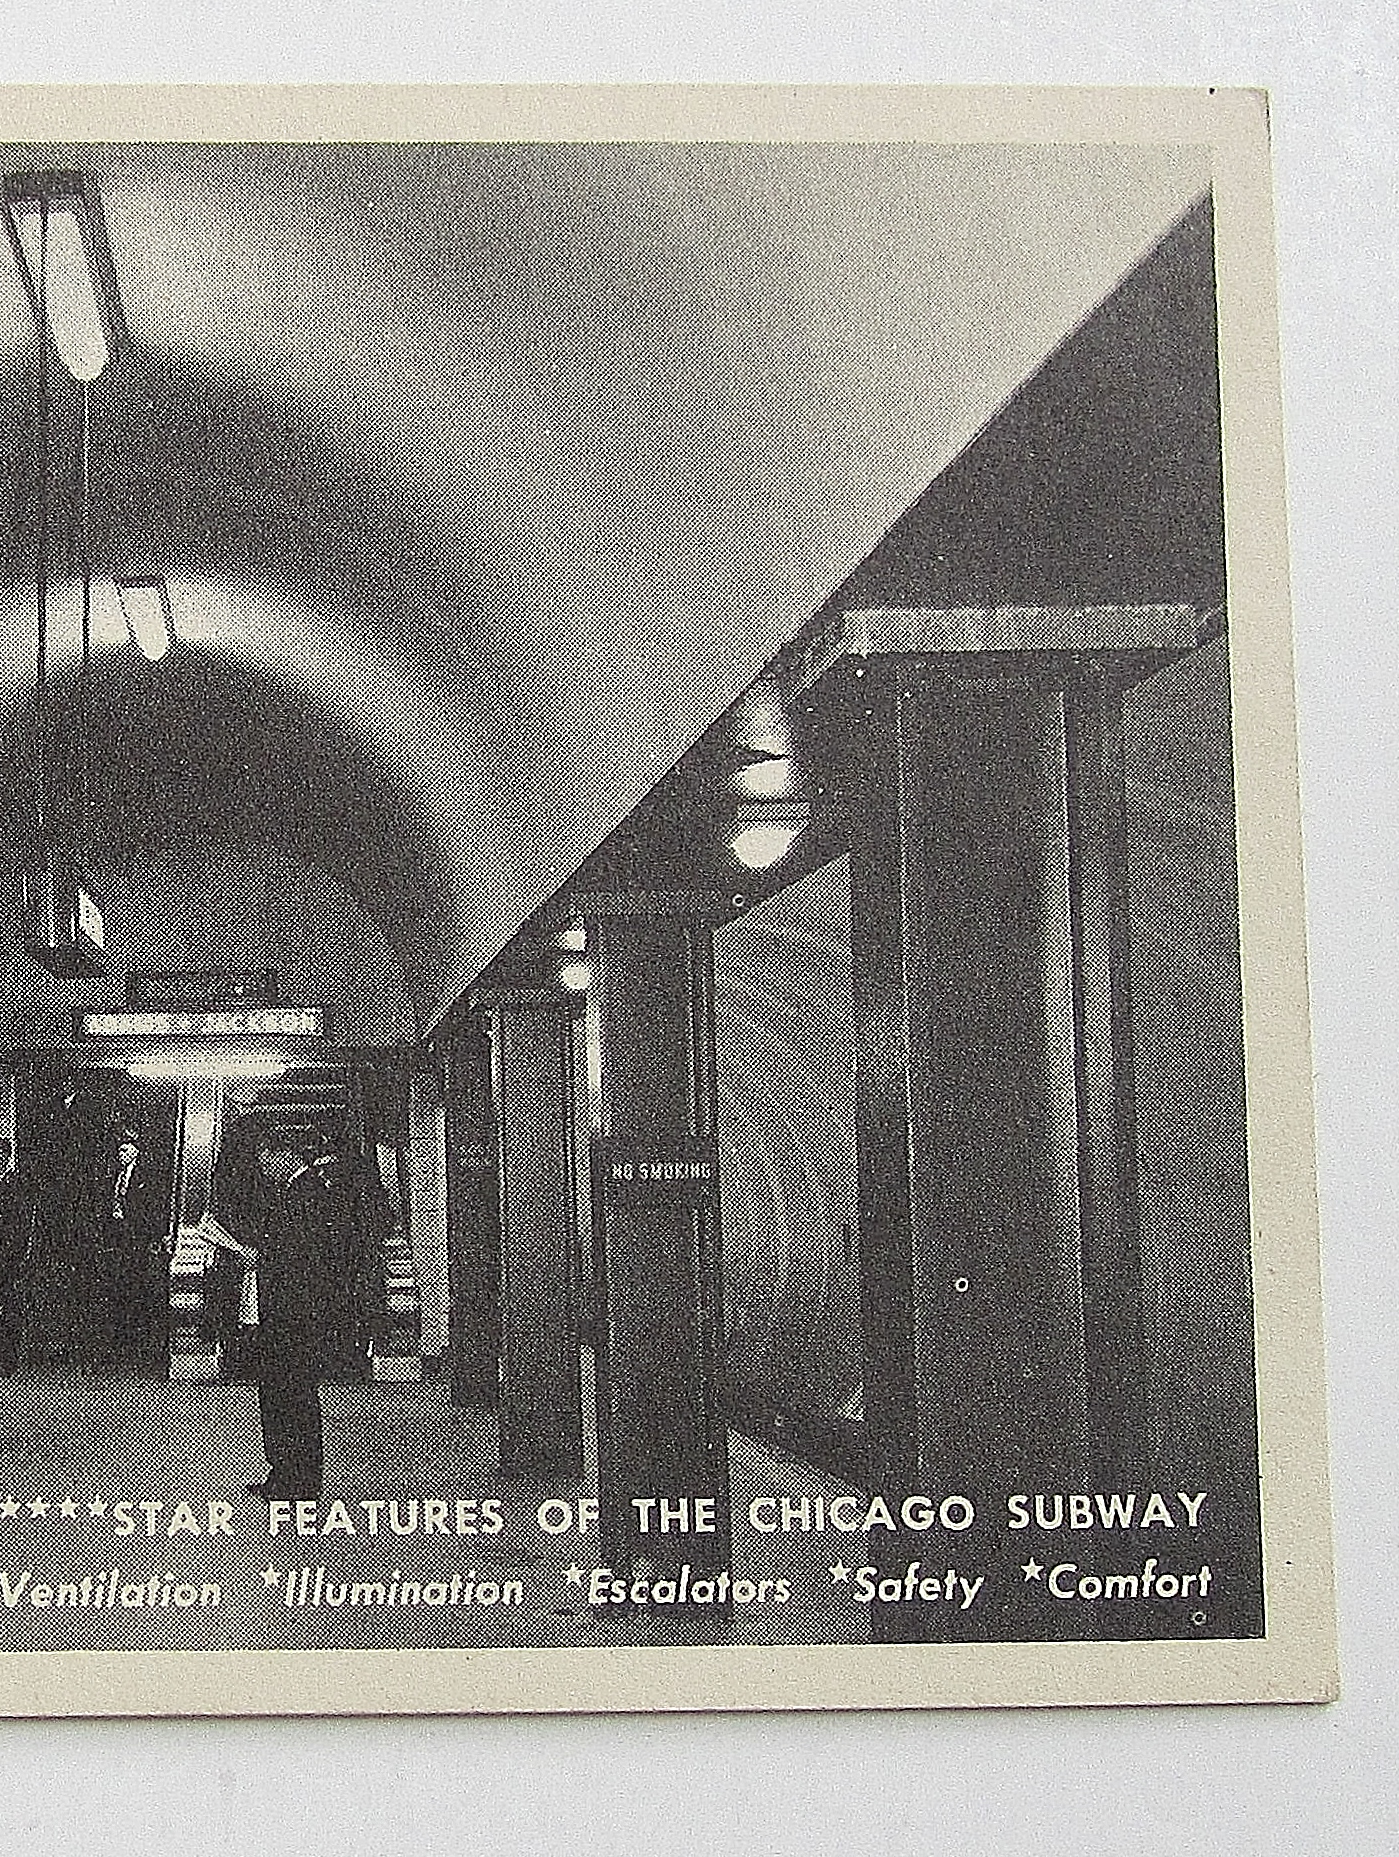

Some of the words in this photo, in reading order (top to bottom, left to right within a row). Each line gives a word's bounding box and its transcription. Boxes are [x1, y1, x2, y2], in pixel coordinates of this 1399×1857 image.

[202, 1012, 319, 1035] JACKSON
[611, 1162, 634, 1180] NO
[639, 1161, 712, 1180] SMOKING
[268, 1497, 505, 1537] FEATURES
[536, 1497, 600, 1534] OF
[632, 1497, 717, 1533] THE
[749, 1494, 976, 1532] CHICAGO
[1007, 1492, 1209, 1531] SUBWAY
[0, 1566, 222, 1608] Ventilation
[284, 1565, 525, 1608] Illumination
[587, 1564, 792, 1606] Escalators
[853, 1561, 985, 1611] Safety
[1047, 1558, 1214, 1601] Comfort
